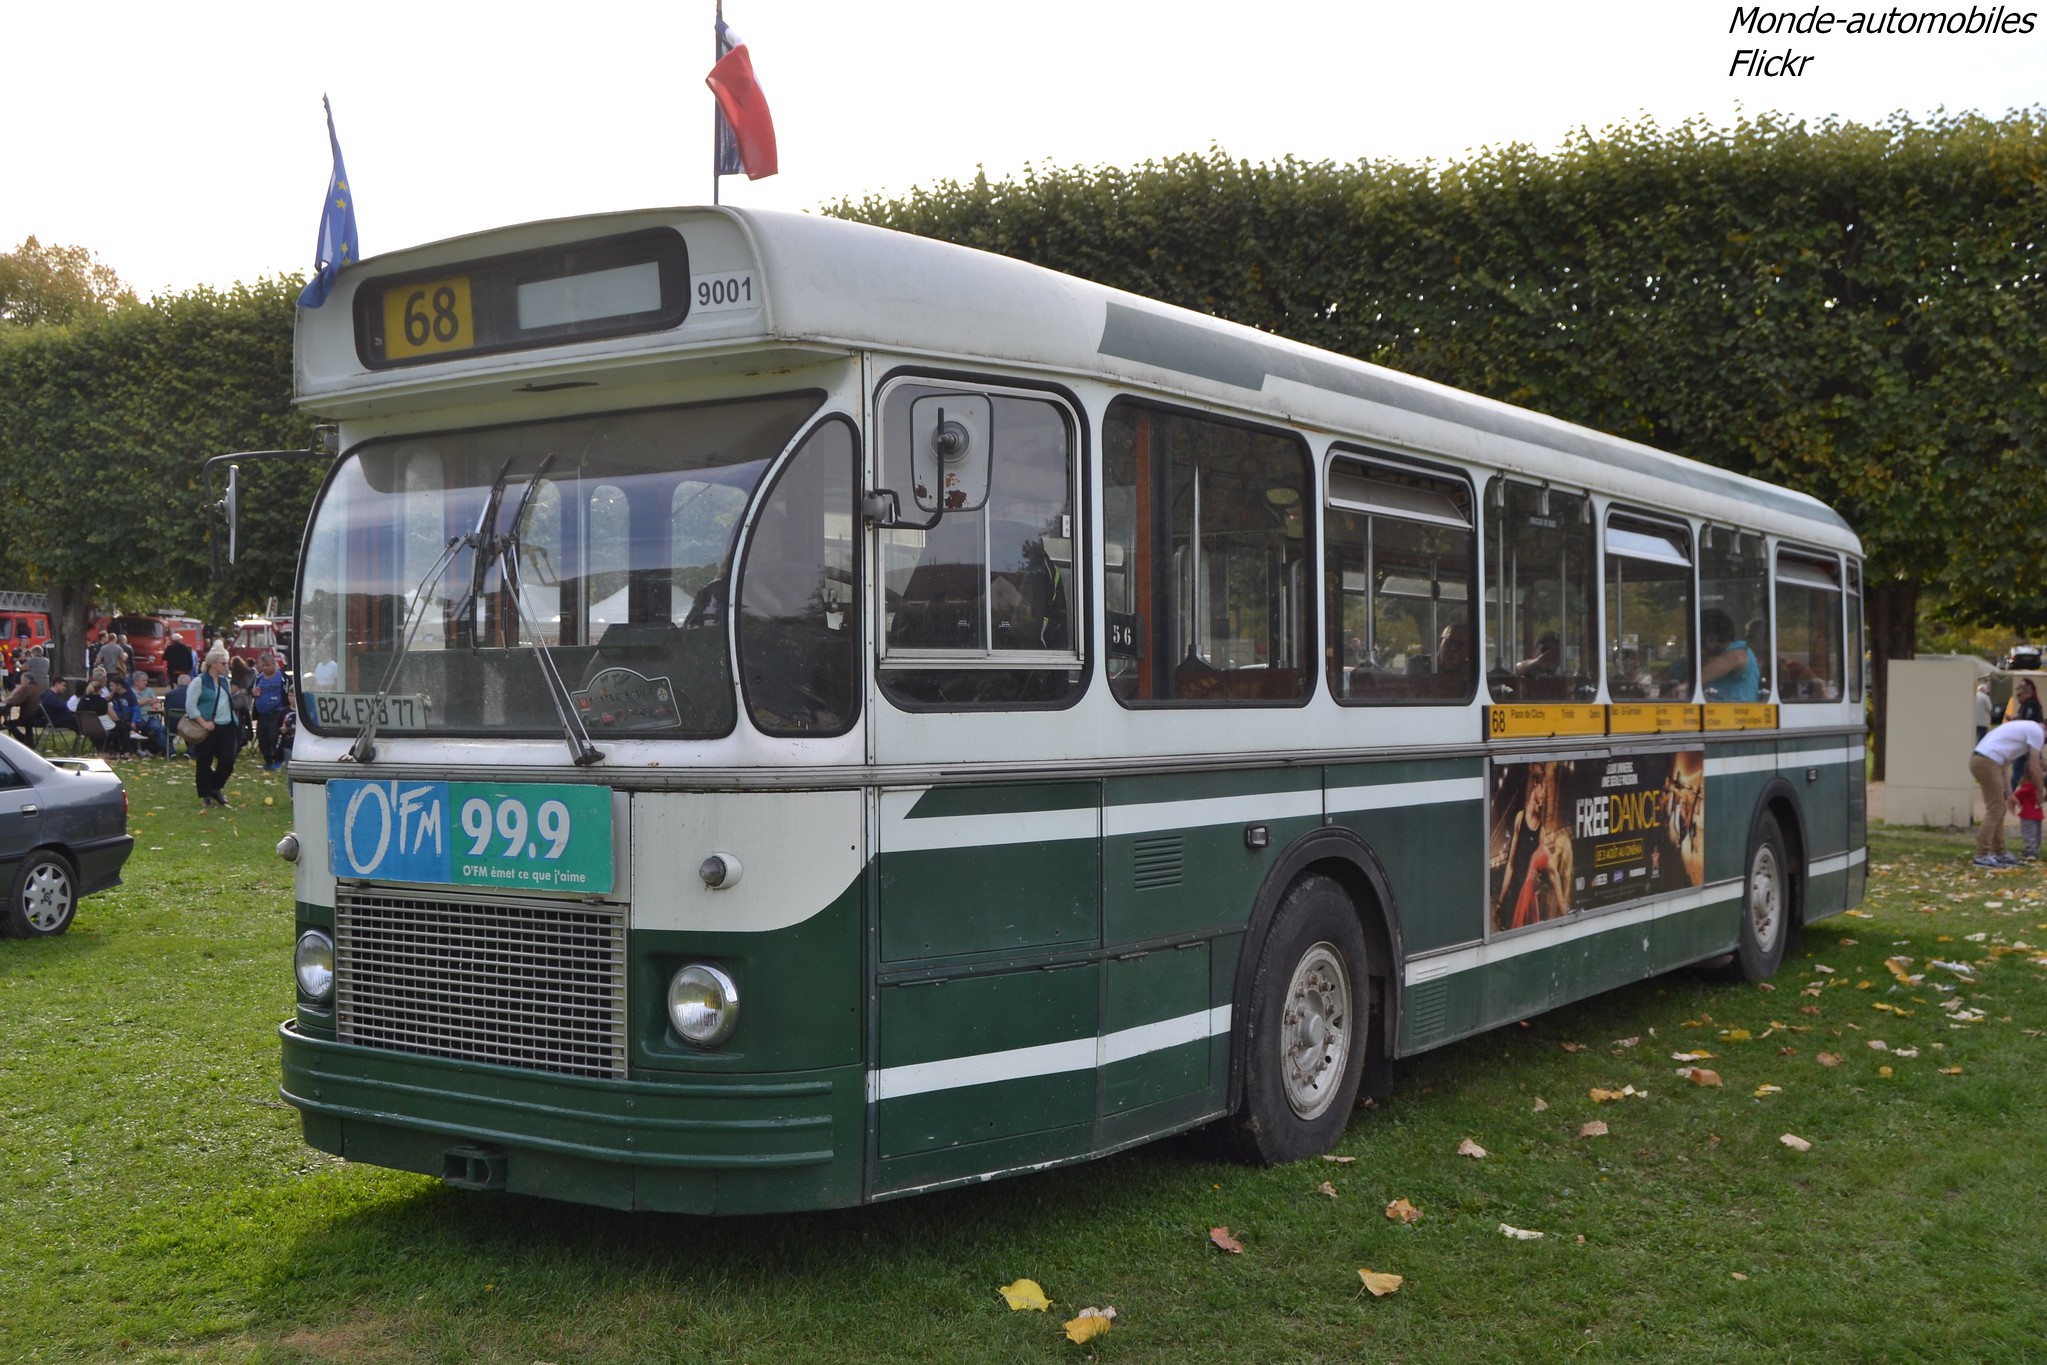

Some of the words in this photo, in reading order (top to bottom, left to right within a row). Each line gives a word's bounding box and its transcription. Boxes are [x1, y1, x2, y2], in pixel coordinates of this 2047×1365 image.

[697, 275, 753, 306] 9001
[403, 285, 460, 347] 68
[1113, 625, 1131, 645] 56
[318, 697, 351, 723] 824
[392, 699, 414, 726] 77
[1492, 710, 1506, 733] 68
[344, 780, 441, 875] O'FM
[461, 798, 570, 859] 99.9
[1576, 795, 1609, 838] FREE
[1610, 790, 1660, 833] DANCE
[463, 865, 488, 877] O'FM
[491, 866, 515, 879] émet
[518, 871, 529, 879] ce
[532, 871, 551, 883] que
[554, 869, 586, 884] j'aime
